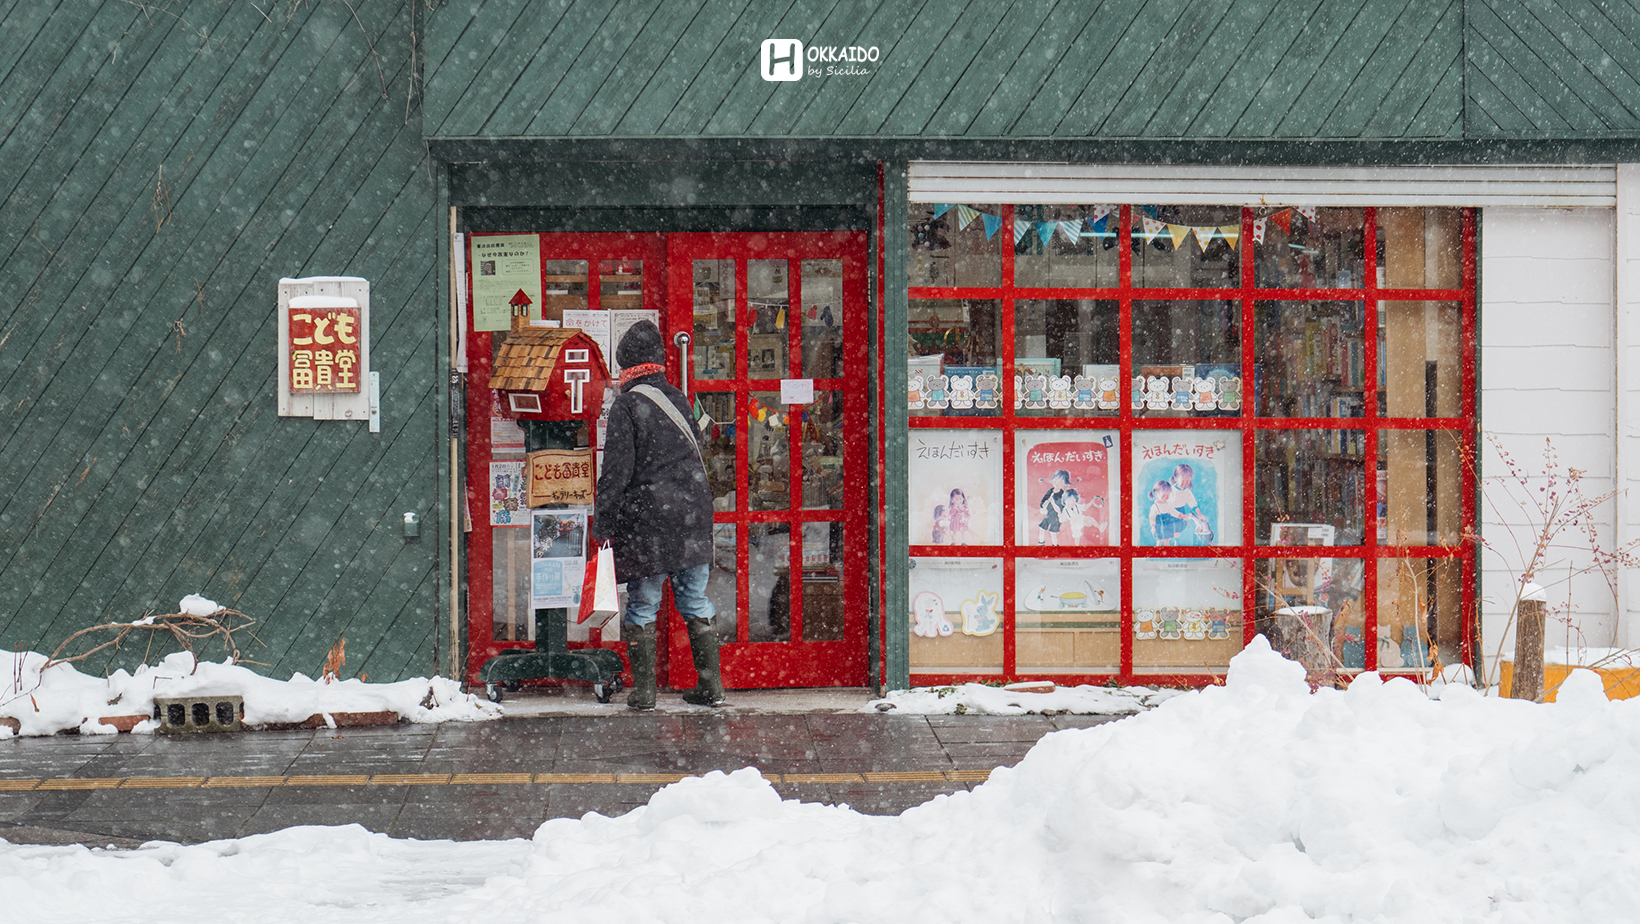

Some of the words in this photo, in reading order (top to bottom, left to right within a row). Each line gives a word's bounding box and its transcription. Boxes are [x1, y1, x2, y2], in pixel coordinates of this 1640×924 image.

[292, 312, 357, 345] こども
[916, 438, 989, 460] えほんだいすき
[1142, 443, 1215, 460] えほんだいすき
